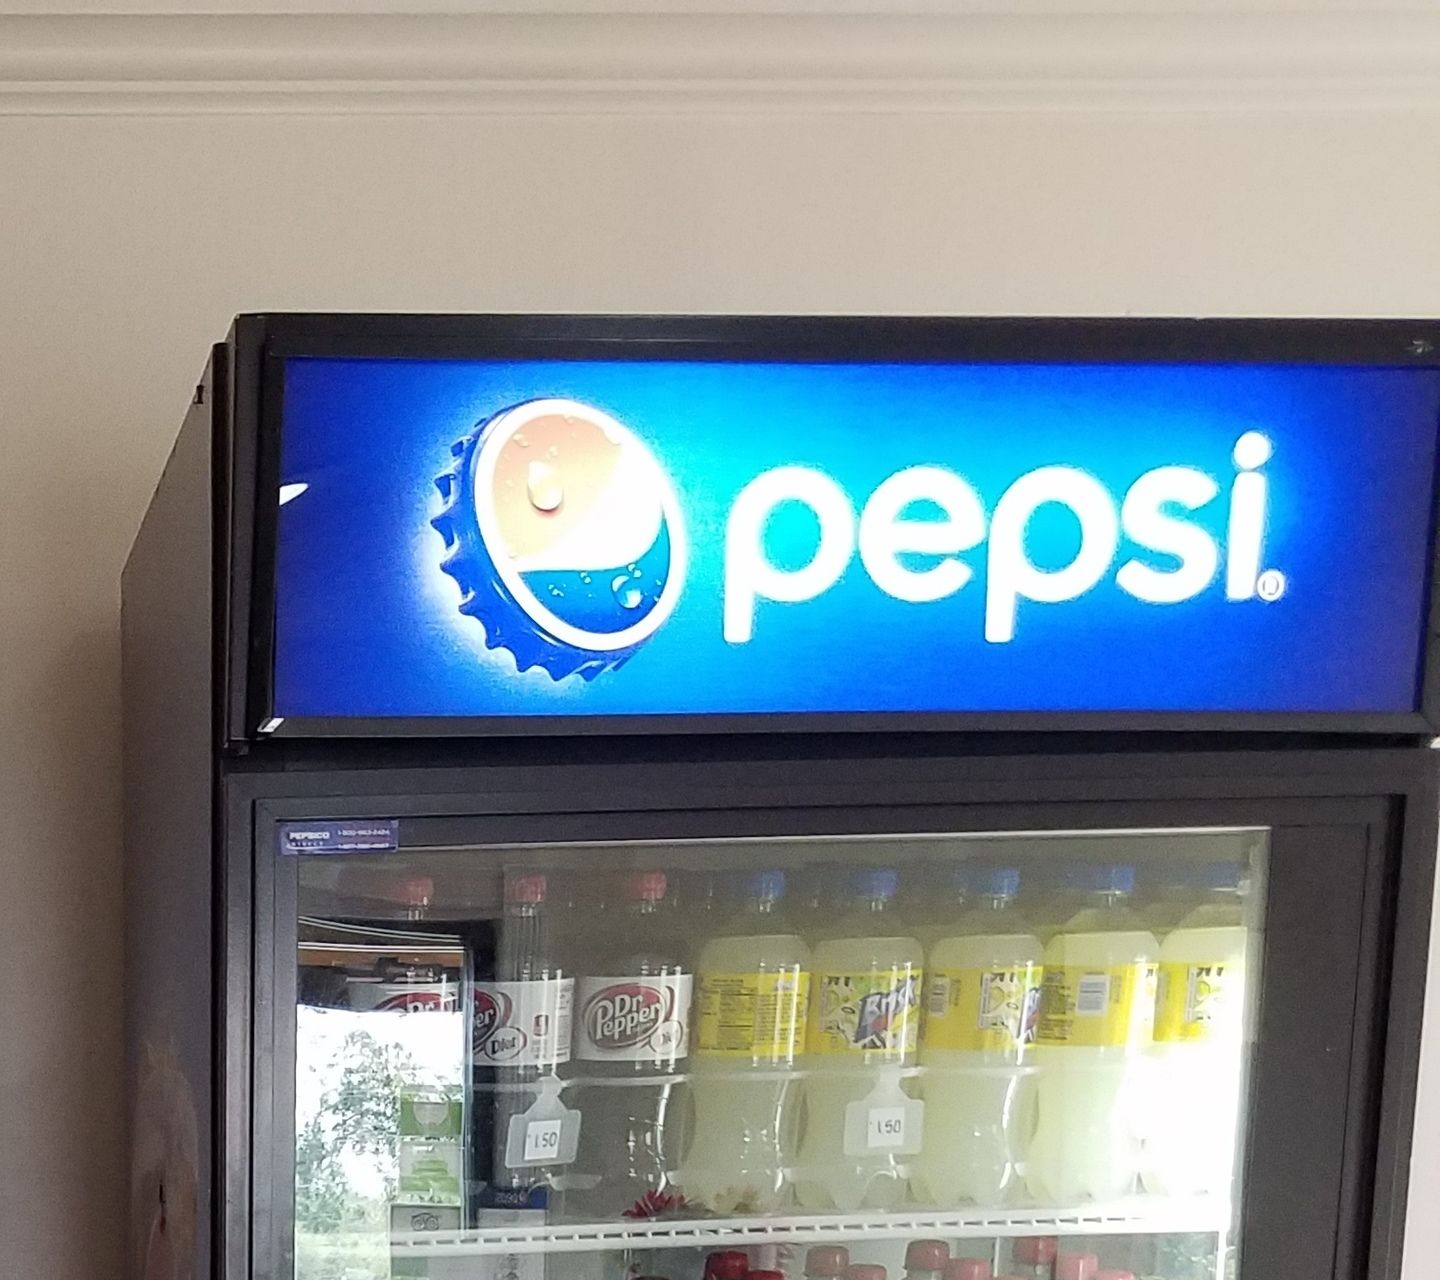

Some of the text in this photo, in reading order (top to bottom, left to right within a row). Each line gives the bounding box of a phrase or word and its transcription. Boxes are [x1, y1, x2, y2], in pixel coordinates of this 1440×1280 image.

[724, 430, 1270, 643] pepsi
[593, 1000, 663, 1041] Pepper
[614, 993, 643, 1014] Dr
